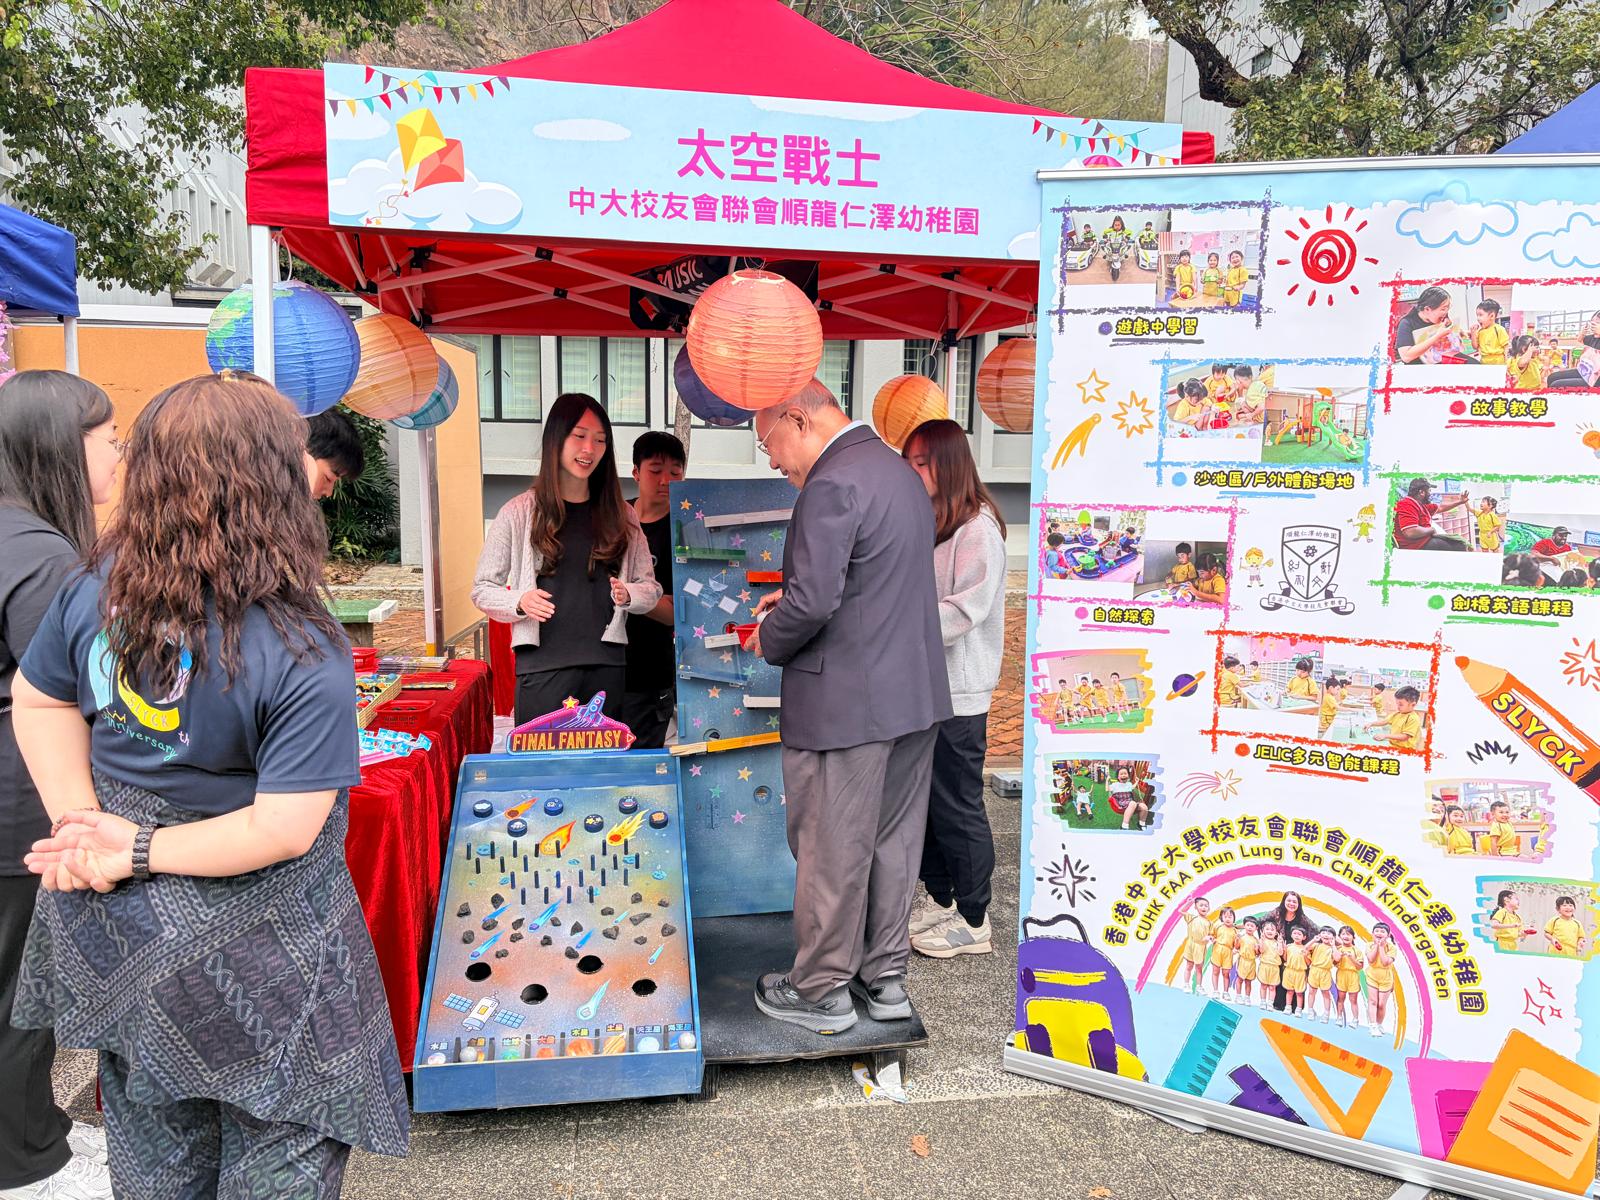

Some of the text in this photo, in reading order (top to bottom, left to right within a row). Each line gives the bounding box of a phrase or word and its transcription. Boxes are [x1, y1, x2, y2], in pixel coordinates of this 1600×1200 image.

[677, 128, 881, 187] 太空戰士
[568, 187, 980, 236] 中大校友會聯會順龍仁澤幼稚園
[657, 259, 704, 291] MUSIC
[1115, 316, 1199, 337] 遊戲中學習
[1470, 397, 1549, 418] 故事教學
[1194, 471, 1355, 490] 沙池區/戶外體能場地
[1093, 607, 1155, 626] 自然探索
[1451, 594, 1574, 617] 劍橋英語課程
[512, 730, 622, 752] FINAL FANTASY
[1492, 692, 1585, 776] SLYCK
[1136, 845, 1449, 998] CUHK FAA Shun Lung Yan Chak Kindergarten
